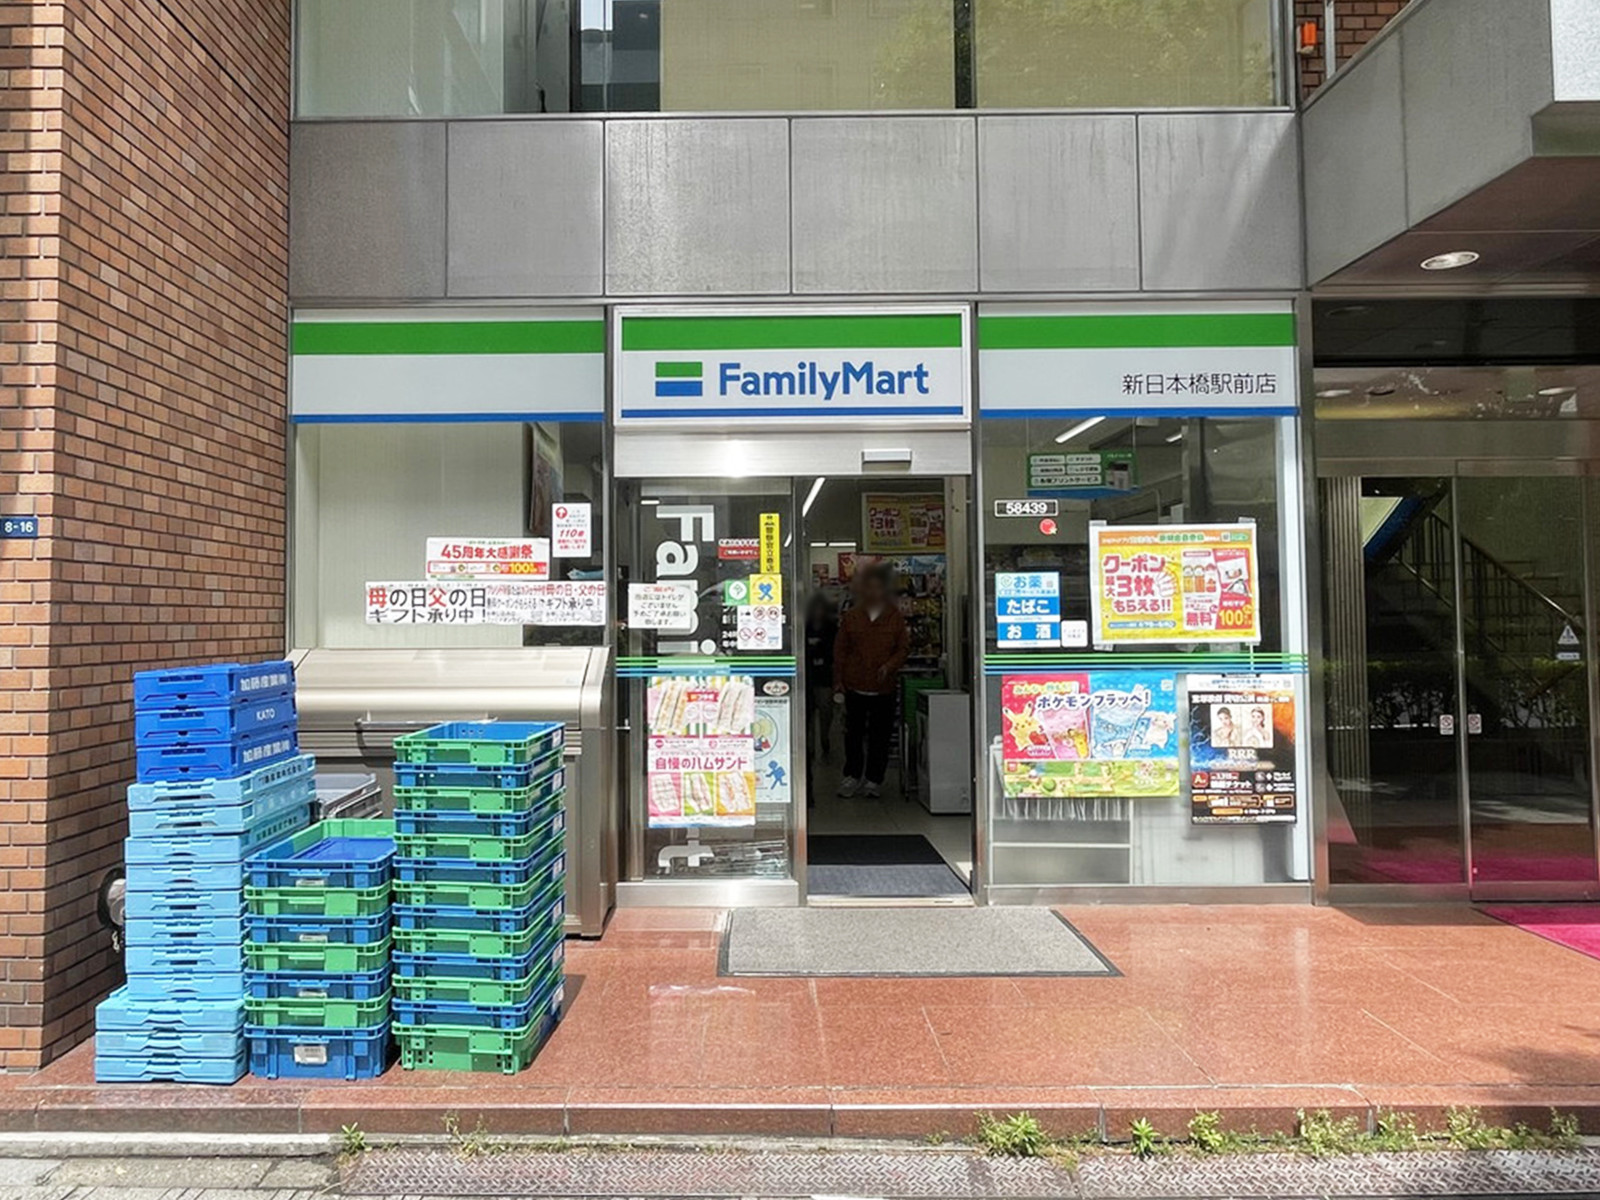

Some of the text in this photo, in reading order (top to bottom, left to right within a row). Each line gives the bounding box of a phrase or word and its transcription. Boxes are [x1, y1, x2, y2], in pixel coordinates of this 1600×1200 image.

[718, 361, 930, 401] FamilyMart
[1122, 373, 1277, 395] 新日本橋駅前店
[1006, 502, 1047, 514] 58439
[4, 521, 34, 533] 8-16
[1103, 554, 1166, 573] クーポン
[368, 587, 486, 608] 母の日父の日
[1007, 599, 1051, 615] たばこ
[256, 707, 276, 720] KATO
[655, 757, 748, 770] 自慢のハムサンド
